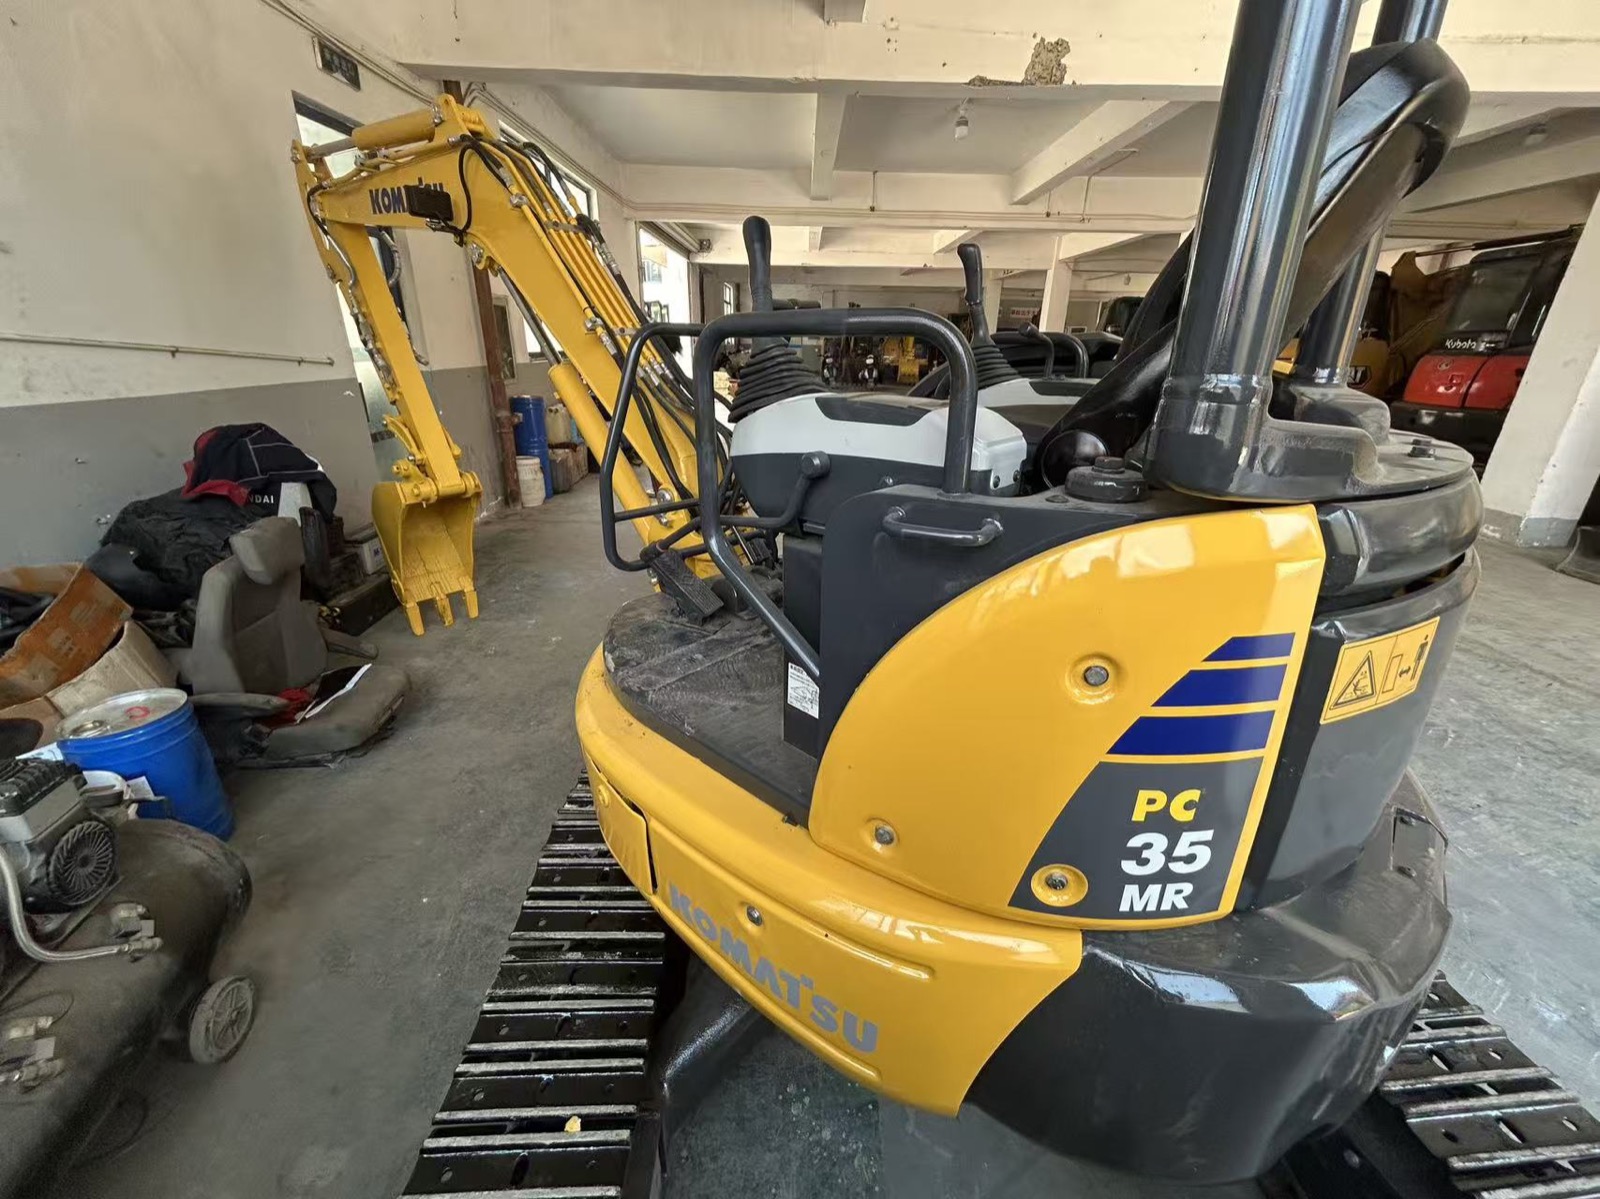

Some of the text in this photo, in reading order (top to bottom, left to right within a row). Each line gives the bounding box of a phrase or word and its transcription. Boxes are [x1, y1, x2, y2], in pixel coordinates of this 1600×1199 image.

[1445, 339, 1477, 349] Kubota
[1131, 788, 1201, 822] PC
[1120, 829, 1214, 876] 35
[1118, 882, 1194, 912] MR
[668, 876, 879, 1054] KOMATSU
